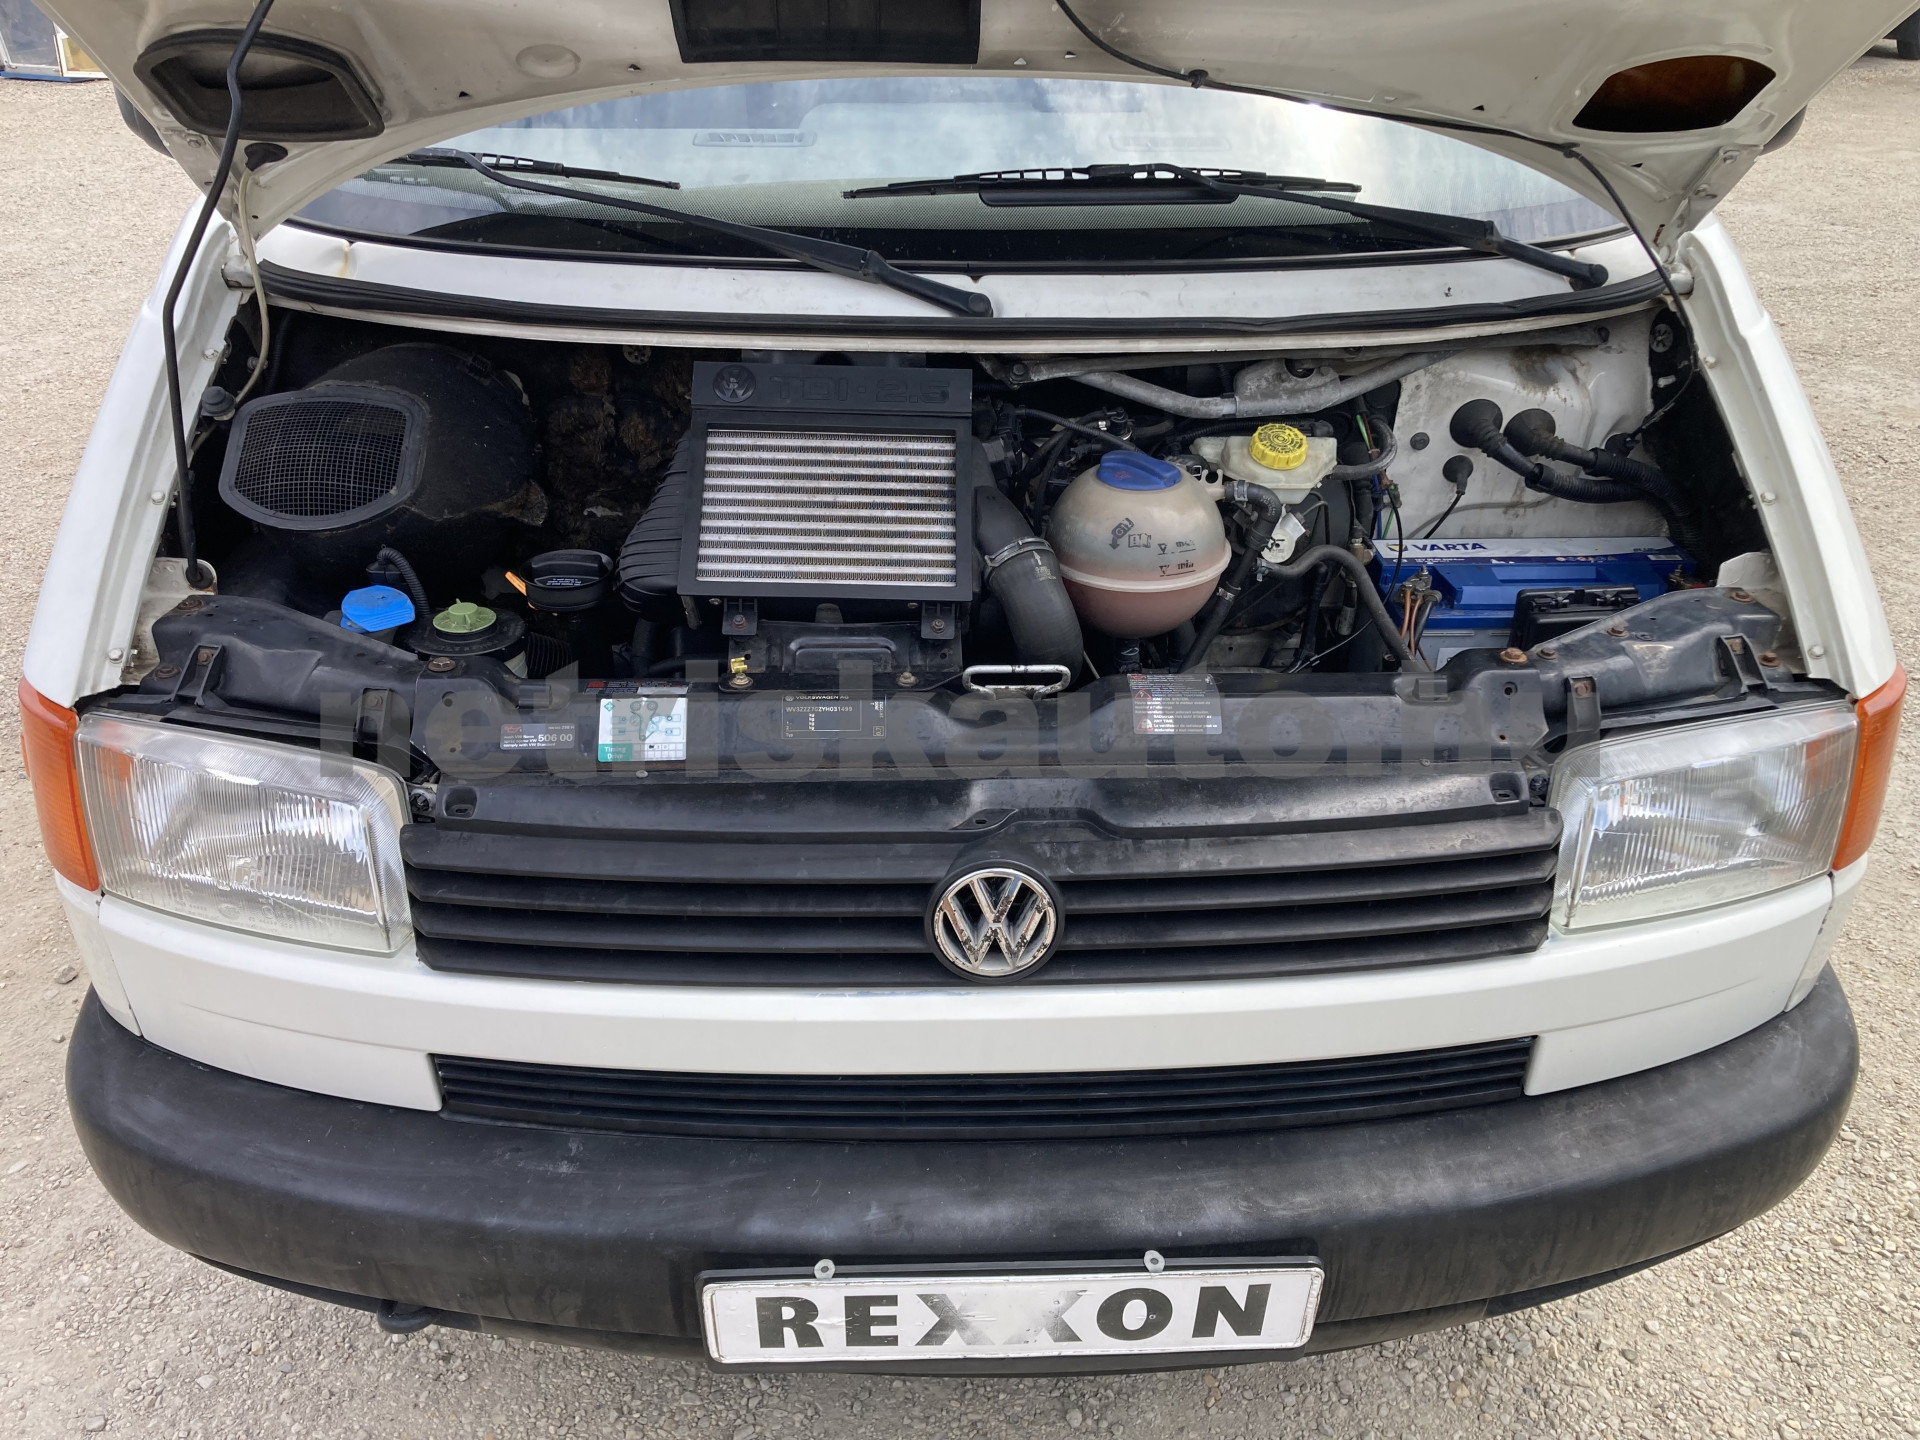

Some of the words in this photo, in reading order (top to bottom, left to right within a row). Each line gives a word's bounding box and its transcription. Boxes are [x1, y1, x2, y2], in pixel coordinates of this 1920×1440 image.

[1411, 542, 1488, 551] VARTA
[538, 734, 557, 742] 506
[560, 733, 573, 742] 00
[604, 746, 626, 754] Timing
[756, 1283, 1271, 1349] REXXON
